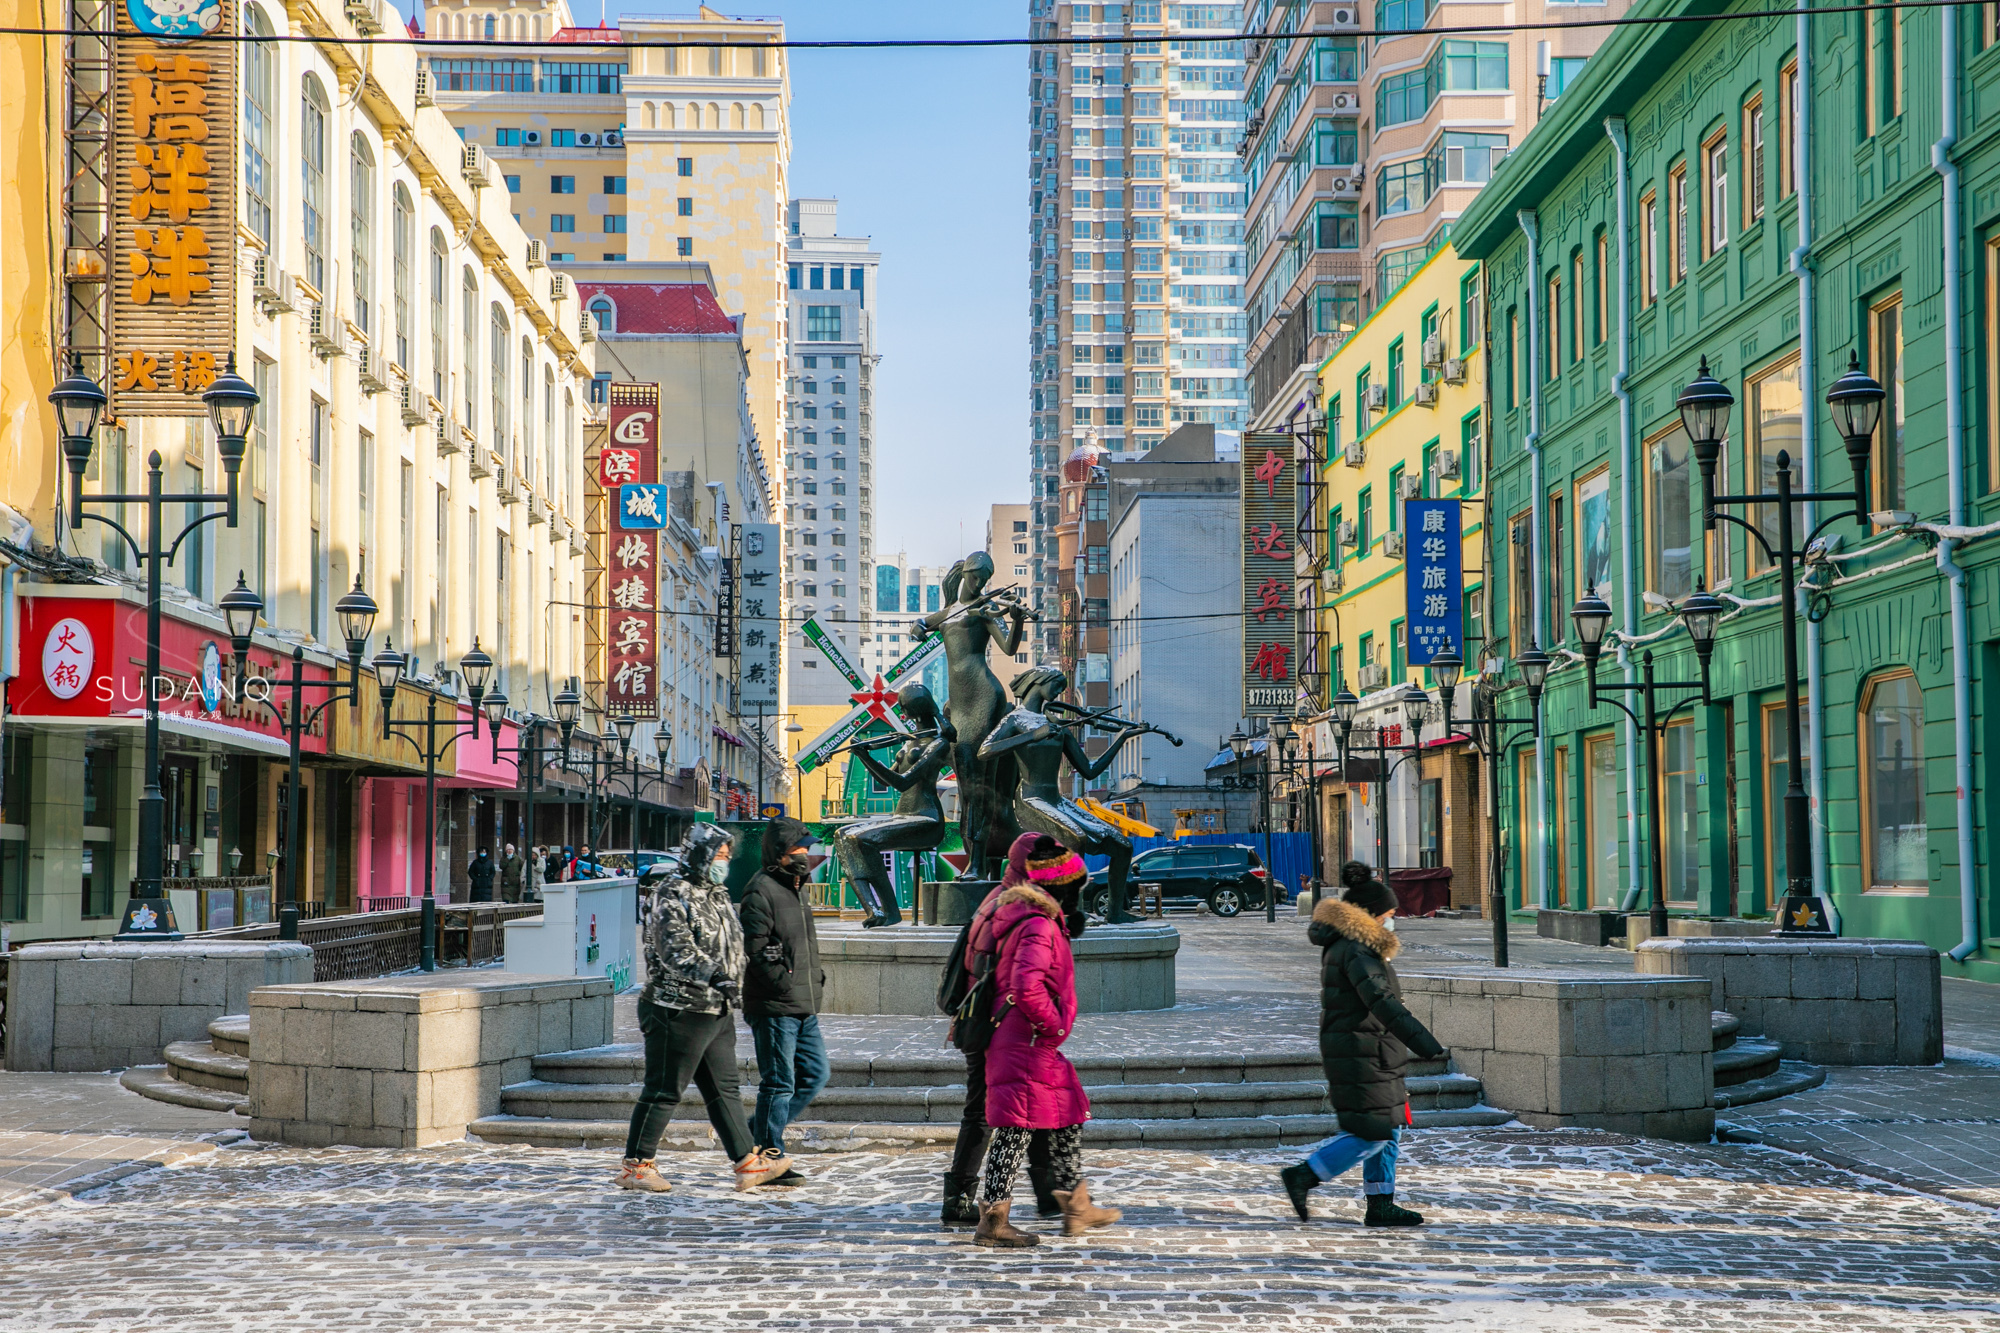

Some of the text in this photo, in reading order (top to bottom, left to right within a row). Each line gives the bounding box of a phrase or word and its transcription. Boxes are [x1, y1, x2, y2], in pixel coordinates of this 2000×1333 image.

[118, 349, 217, 391] 火锅
[1250, 450, 1293, 682] 中达宾馆
[1422, 508, 1448, 619] 康华旅游
[49, 624, 84, 690] 火锅
[816, 634, 851, 676] Heineken
[901, 634, 941, 671] Heineken
[1249, 689, 1294, 705] 87731333
[815, 724, 854, 757] Heineken
